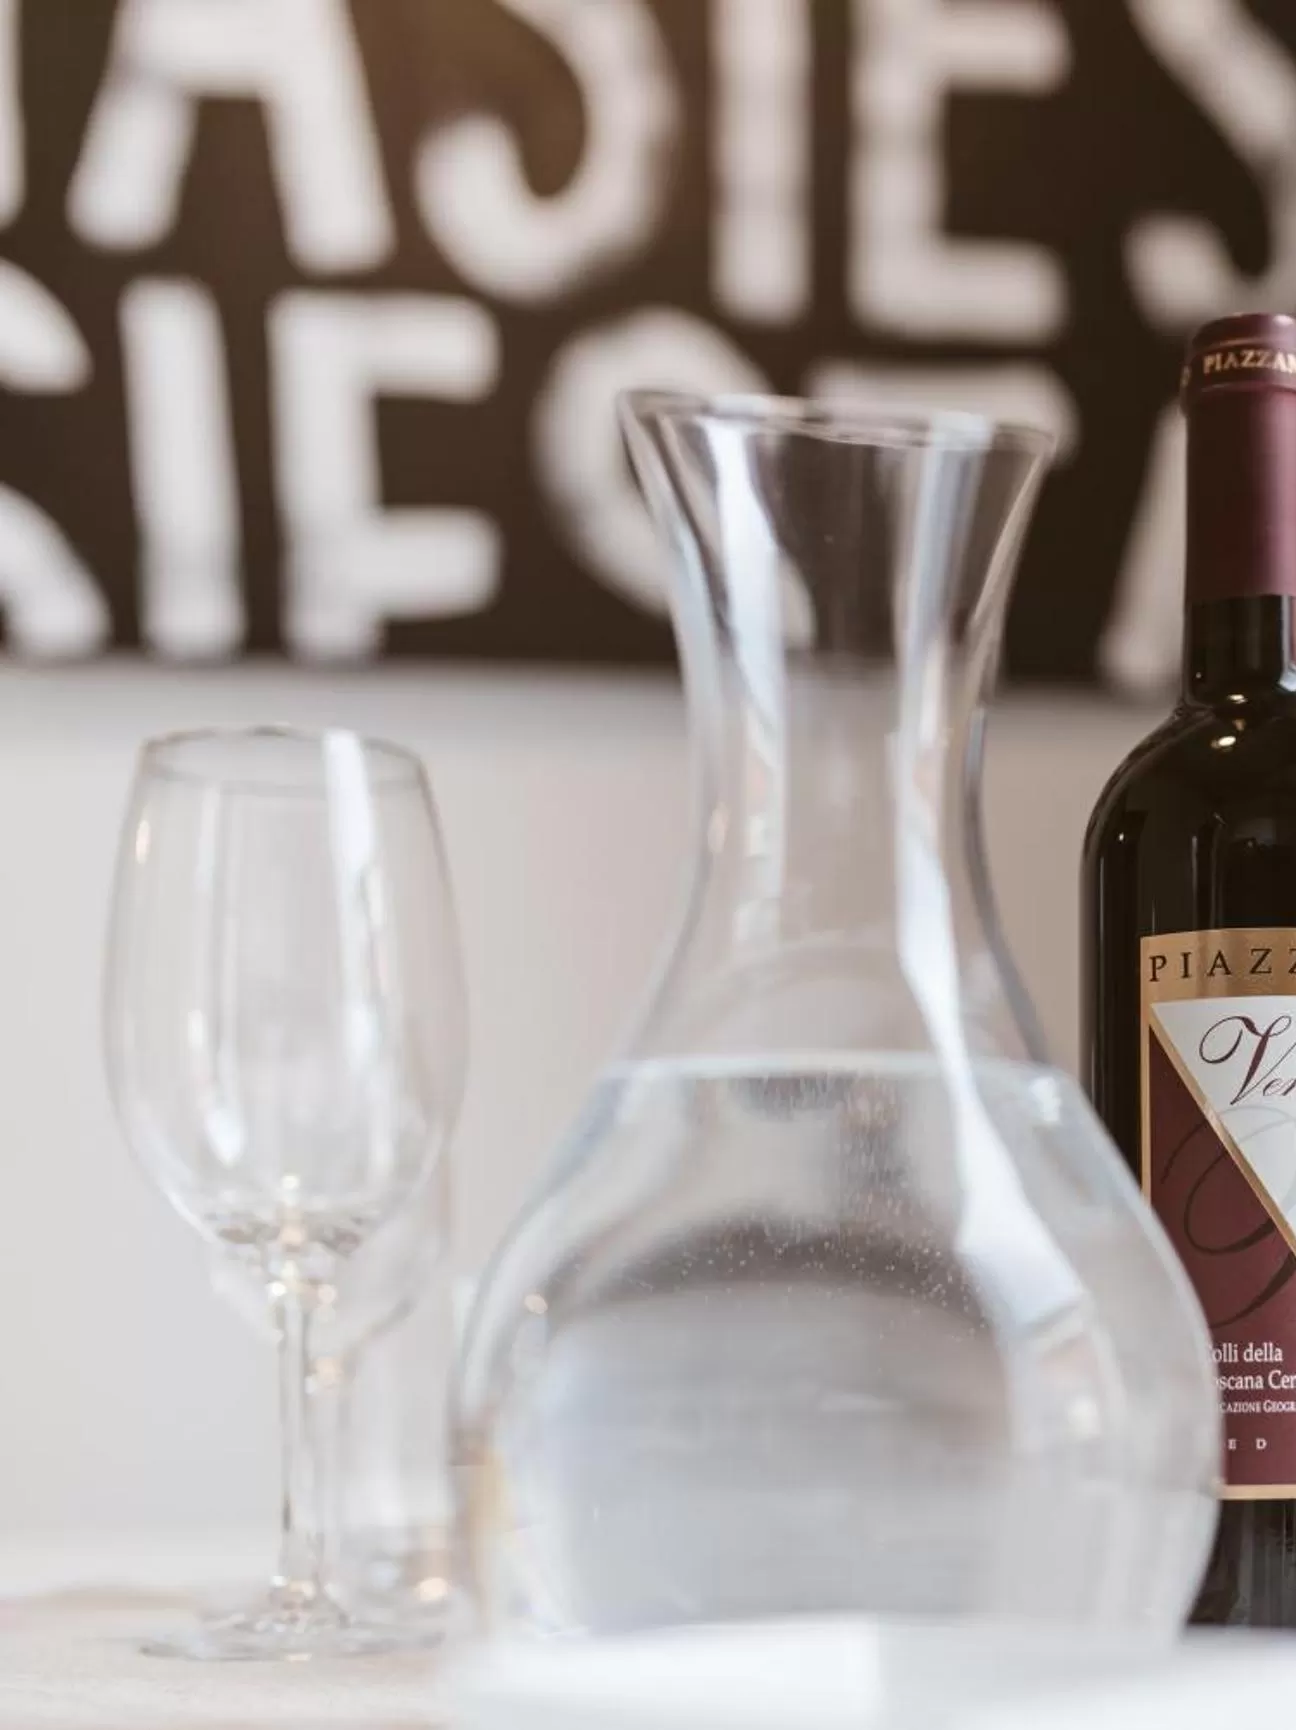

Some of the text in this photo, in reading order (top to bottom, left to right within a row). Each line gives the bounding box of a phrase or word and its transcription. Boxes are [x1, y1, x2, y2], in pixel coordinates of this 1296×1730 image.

[1243, 1342, 1284, 1362] della
[1214, 1374, 1264, 1391] scana
[1228, 1438, 1268, 1450] ED
